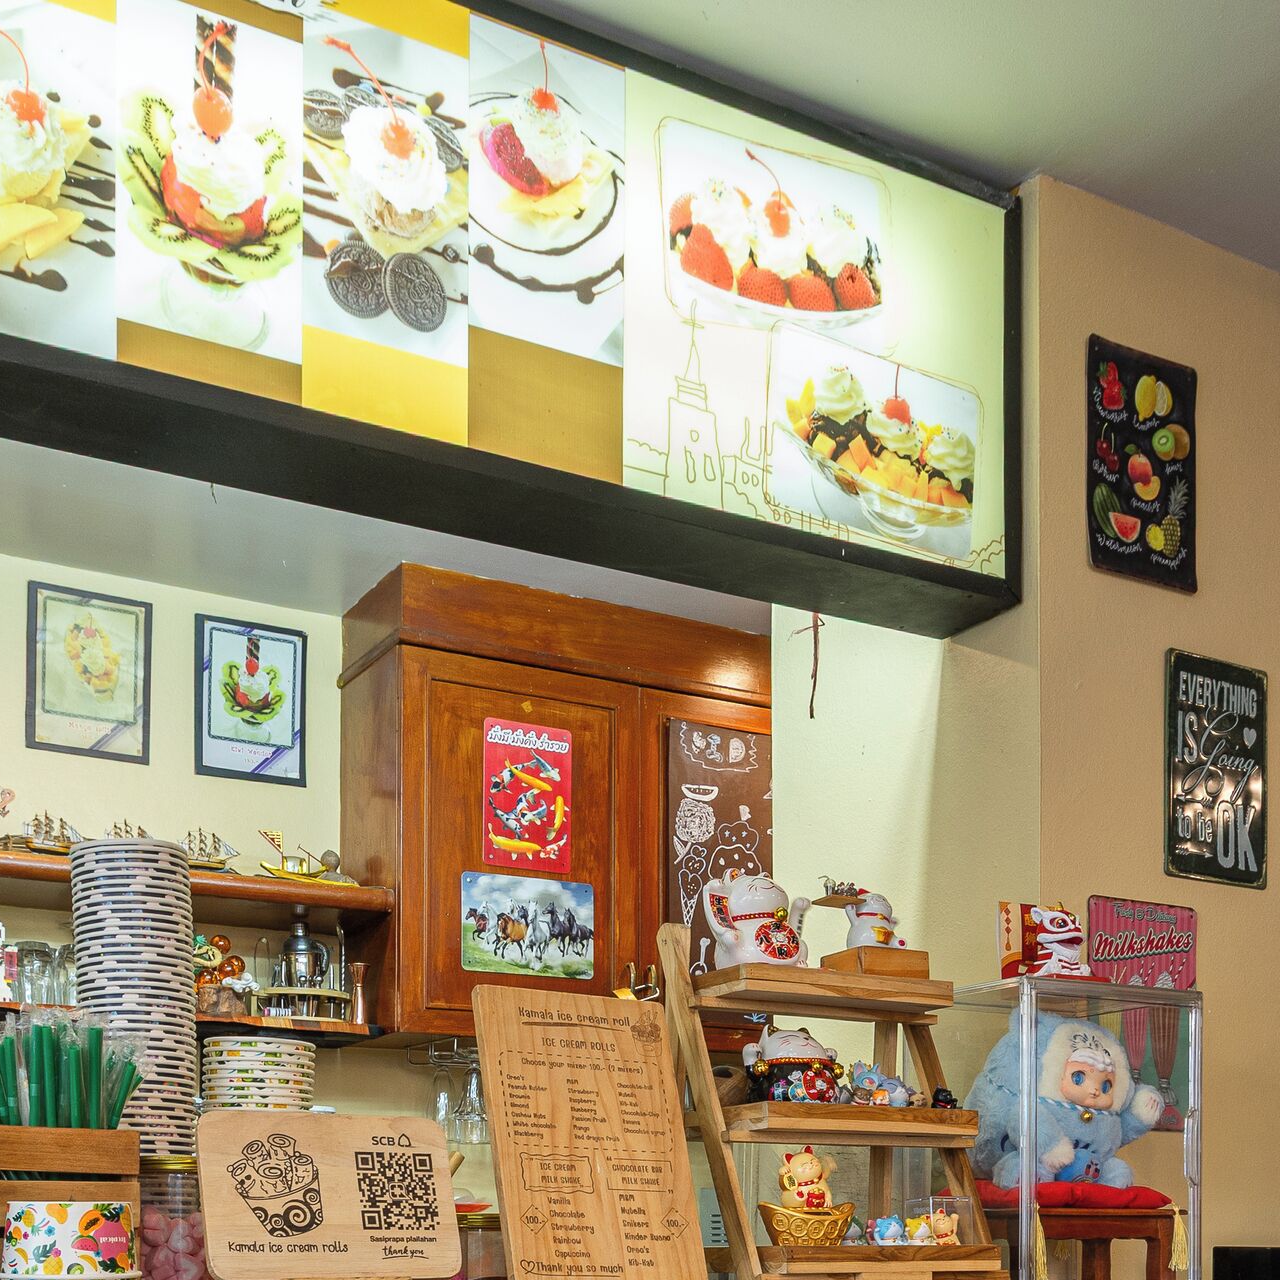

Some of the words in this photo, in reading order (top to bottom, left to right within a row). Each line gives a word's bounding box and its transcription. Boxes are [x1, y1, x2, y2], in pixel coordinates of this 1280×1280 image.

[1178, 671, 1258, 719] EVERYTHING
[1177, 709, 1198, 763] IS
[1182, 704, 1259, 804] Going
[1176, 806, 1191, 839] to
[1197, 809, 1213, 843] be
[1217, 800, 1258, 872] OK
[1093, 925, 1195, 960] Milkshakes
[518, 1006, 553, 1020] Kamala
[557, 1009, 573, 1022] ice
[577, 1012, 609, 1025] cream
[613, 1016, 631, 1027] roll
[542, 1037, 556, 1048] ICE
[560, 1038, 588, 1050] CREAM
[591, 1041, 616, 1052] ROLLS
[521, 1057, 546, 1067] Choose
[549, 1060, 565, 1069] your
[567, 1061, 587, 1070] mixer
[568, 1087, 599, 1097] Strawberry
[371, 1135, 396, 1146] SCB
[540, 1162, 552, 1171] ICE
[554, 1163, 577, 1172] CREAM
[612, 1163, 649, 1173] CHOCOLATE
[651, 1166, 663, 1174] BAR
[541, 1175, 558, 1184] MILK
[560, 1176, 581, 1185] SHAKE
[621, 1177, 638, 1185] MILK
[547, 1196, 572, 1206] Vanilla
[549, 1209, 586, 1219] Chocolate
[621, 1206, 646, 1216] Nutella
[551, 1222, 595, 1234] Strawberry
[622, 1219, 649, 1228] Snikers
[553, 1235, 582, 1245] Rainbow
[625, 1232, 648, 1241] Kinder
[228, 1241, 265, 1252] Kamala
[268, 1241, 284, 1253] ice
[287, 1243, 318, 1253] cream
[322, 1240, 349, 1253] rolls
[626, 1245, 650, 1254] Oreo's
[381, 1245, 409, 1257] thank
[410, 1249, 425, 1260] you
[555, 1249, 591, 1260] Capuccino
[628, 1258, 655, 1267] Kit-Kat
[535, 1261, 563, 1272] Thank
[567, 1263, 583, 1276] you
[585, 1264, 597, 1273] so
[600, 1261, 624, 1273] much
